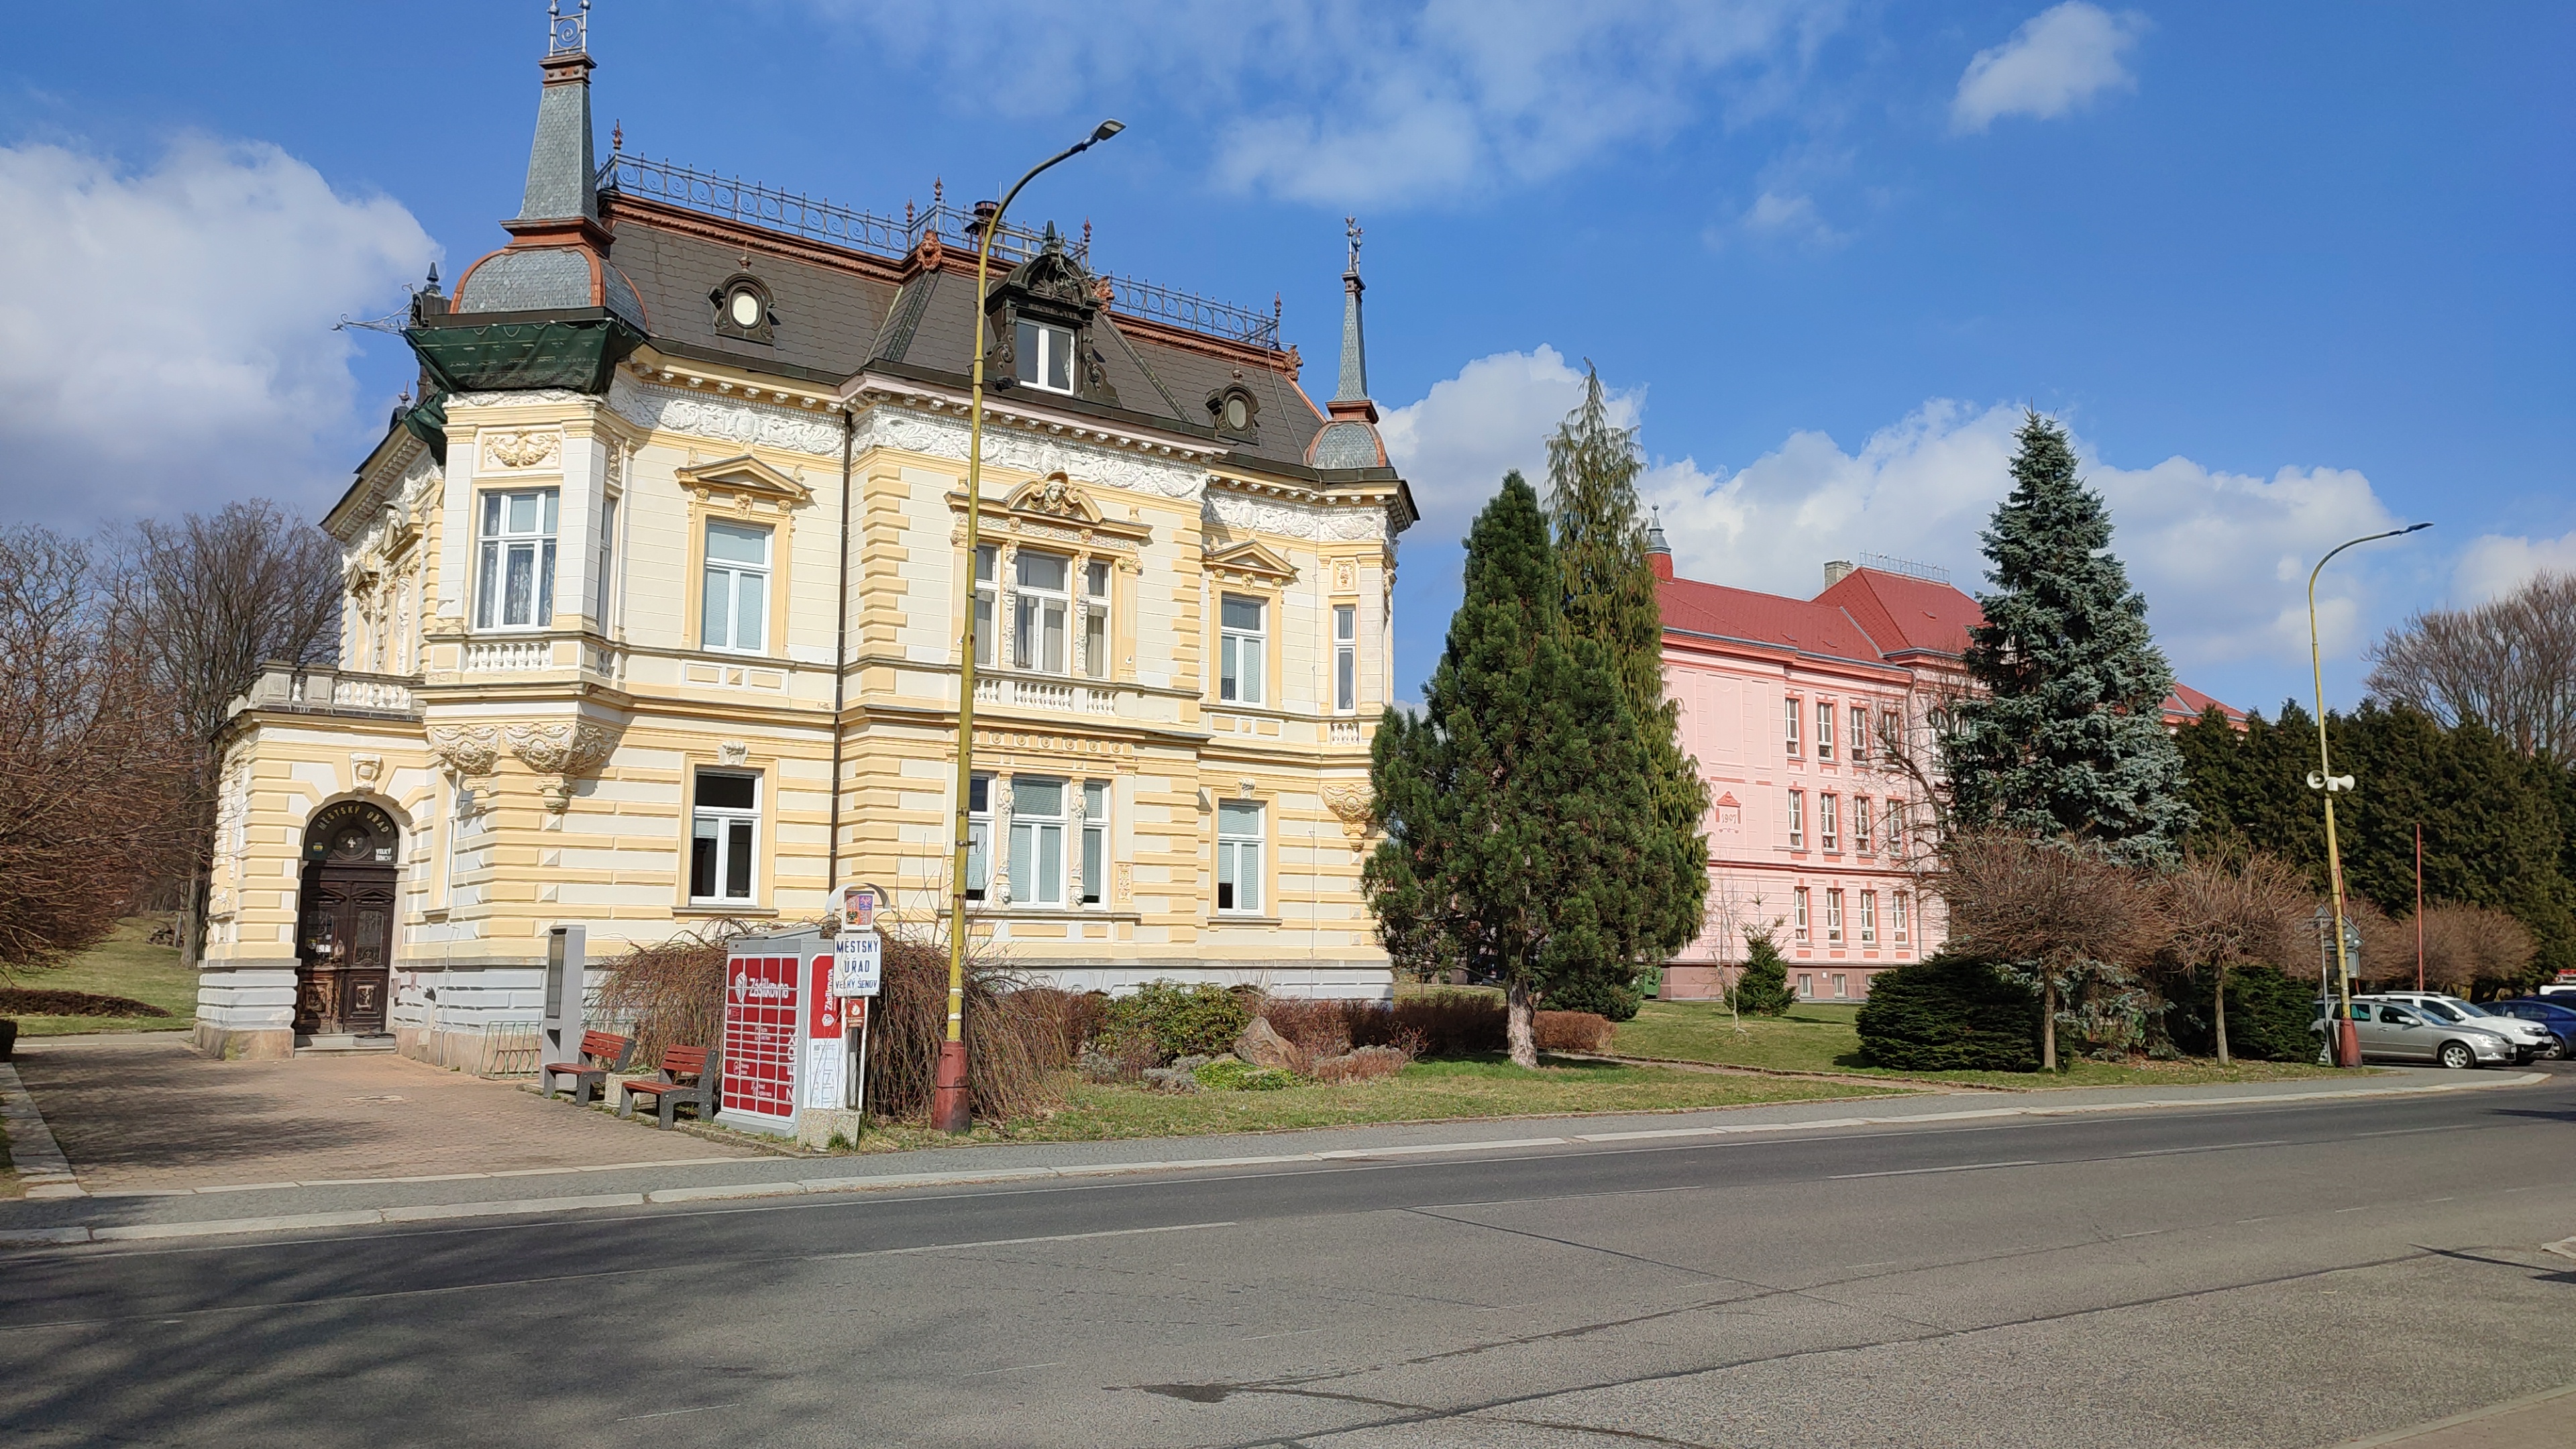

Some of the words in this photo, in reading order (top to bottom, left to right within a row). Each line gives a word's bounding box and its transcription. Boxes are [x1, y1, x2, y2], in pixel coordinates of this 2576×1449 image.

[1722, 814, 1736, 824] 1907
[836, 937, 878, 953] MĚSTSKÝ
[845, 957, 870, 973] ÚŘAD
[749, 977, 789, 999] Zásilkovna
[857, 977, 877, 988] ŠENOV
